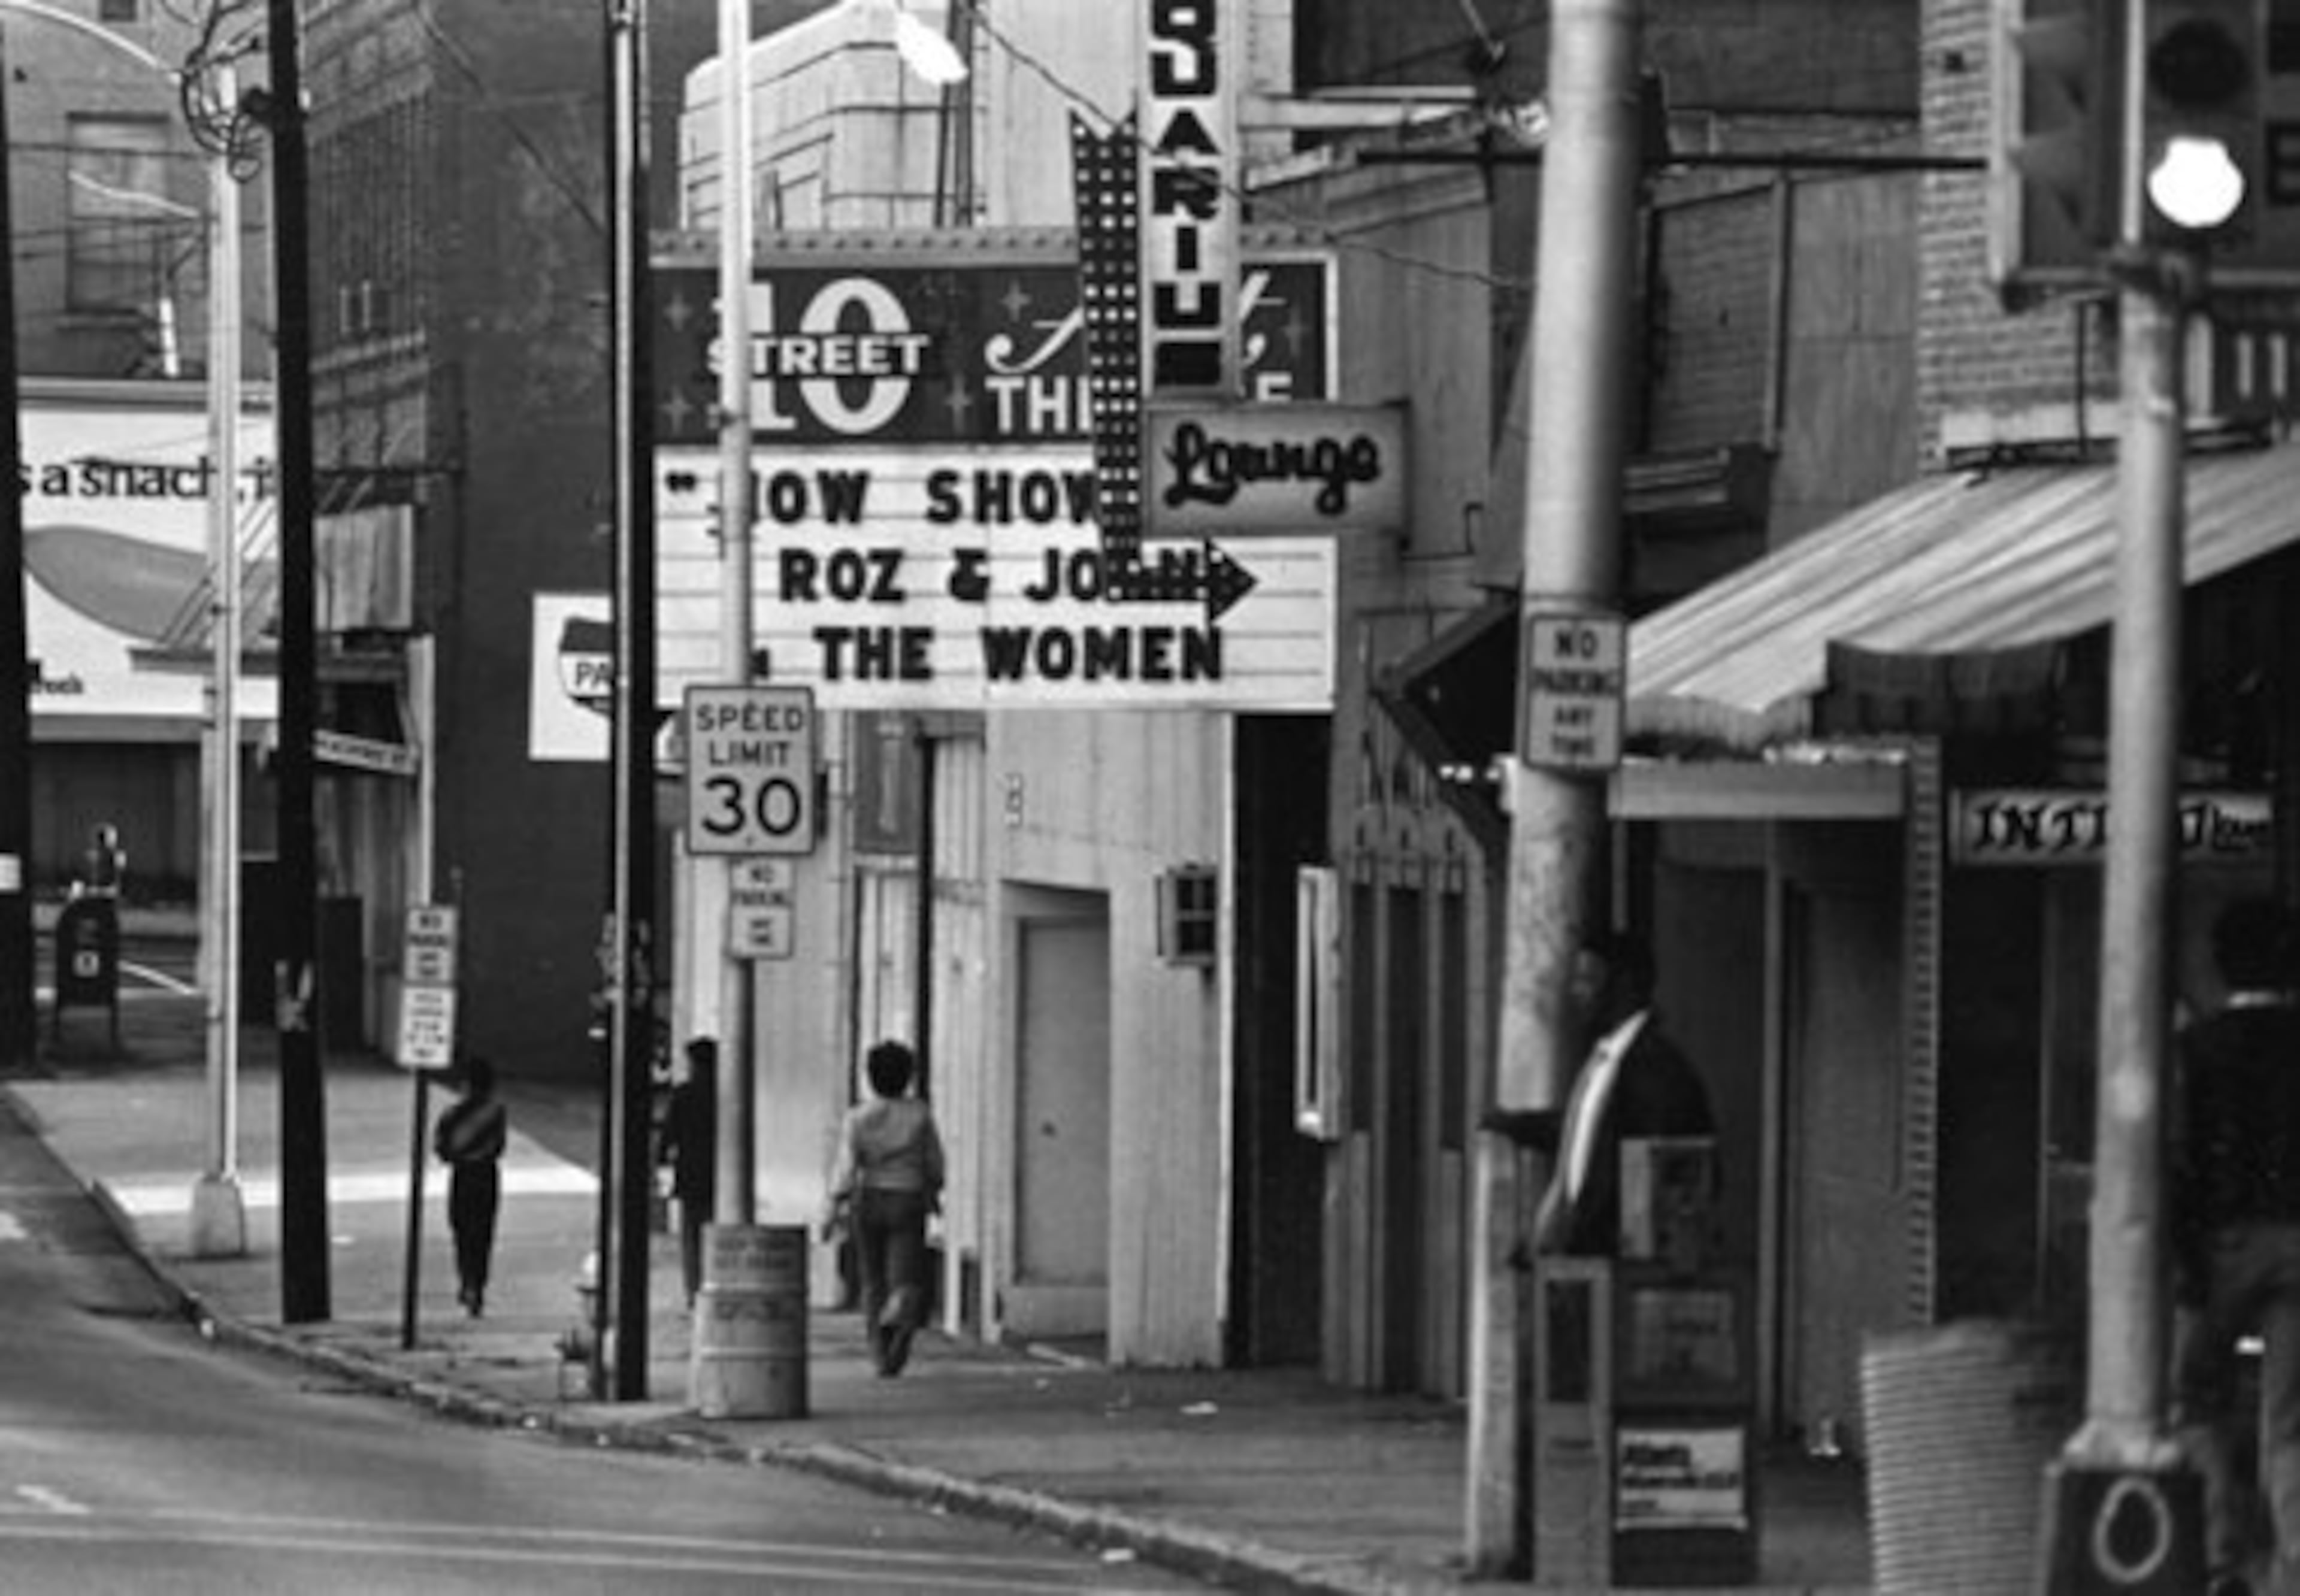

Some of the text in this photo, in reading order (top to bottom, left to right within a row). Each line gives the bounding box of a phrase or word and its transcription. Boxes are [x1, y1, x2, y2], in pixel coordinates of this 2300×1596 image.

[42, 465, 69, 496] a
[1163, 421, 1381, 517] Lounge
[779, 547, 906, 602] ROZ
[948, 547, 989, 602] &
[813, 626, 934, 681] THE
[981, 626, 1222, 682] WOMEN
[1554, 629, 1598, 660] NO
[695, 703, 804, 732] SPEED
[709, 740, 791, 767] LIMIT
[701, 777, 802, 836] 30
